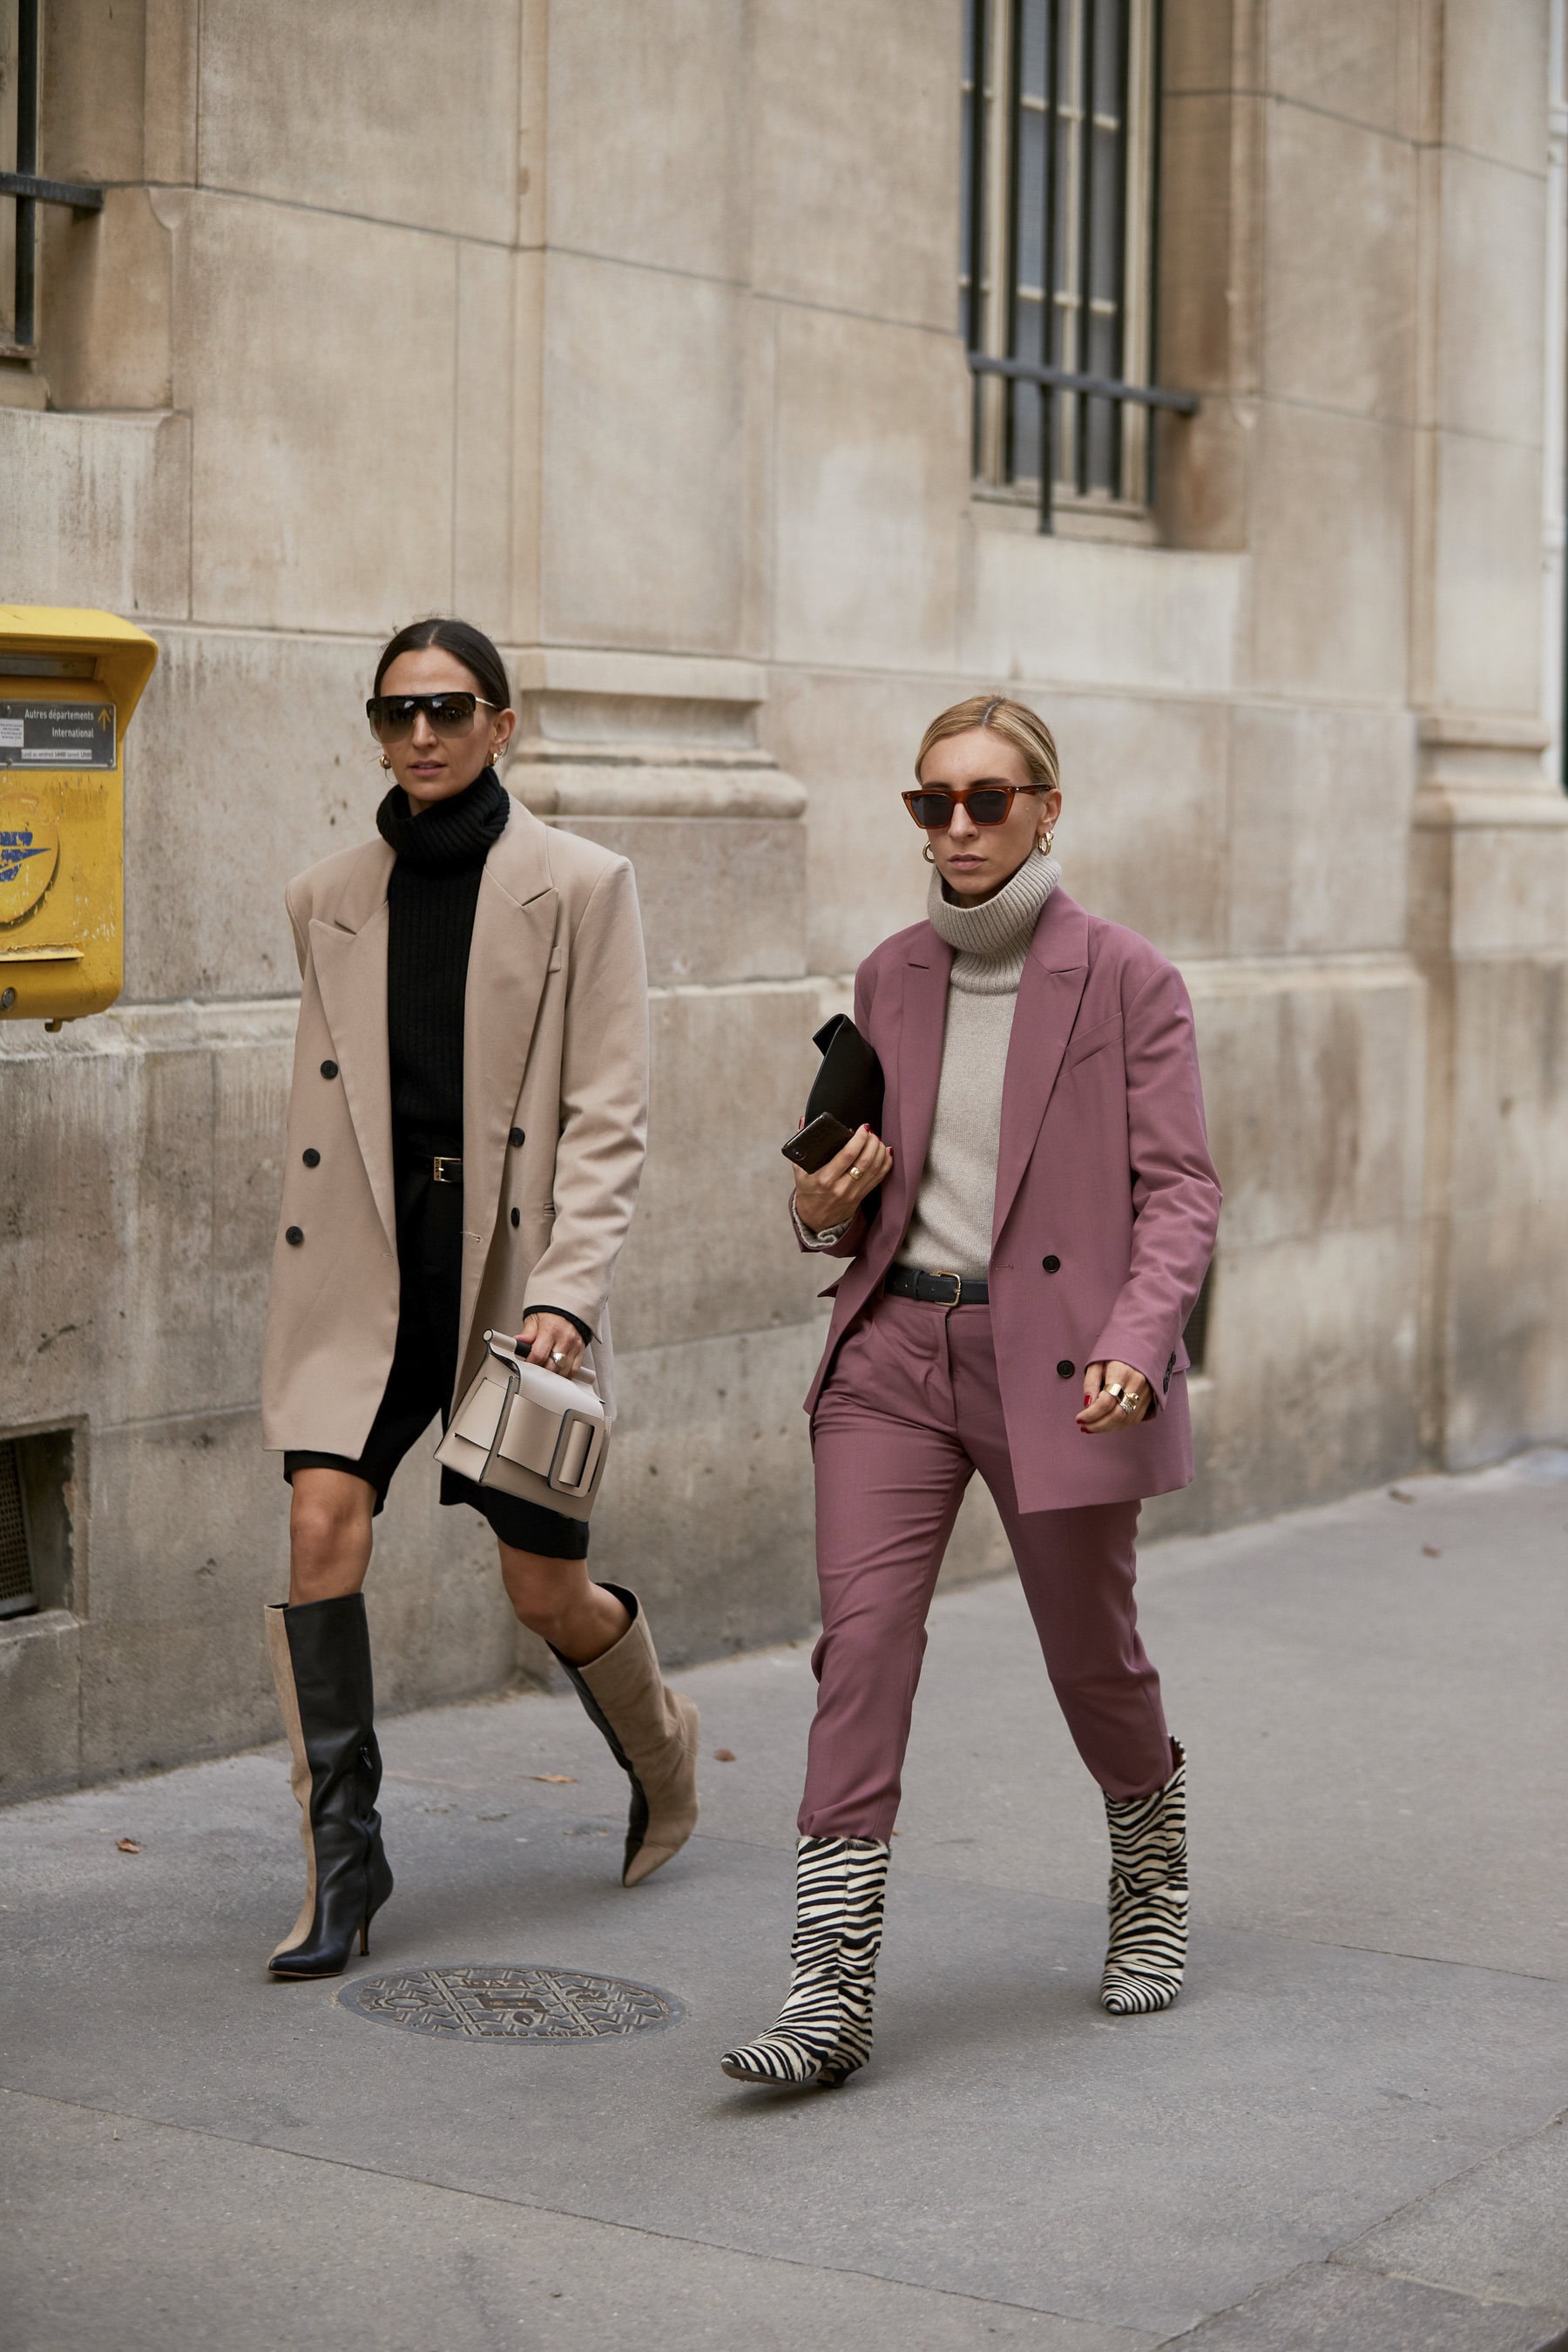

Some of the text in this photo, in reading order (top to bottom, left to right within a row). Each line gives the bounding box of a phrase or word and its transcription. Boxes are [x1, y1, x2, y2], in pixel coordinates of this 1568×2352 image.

[24, 708, 94, 721] Autres départements
[51, 727, 94, 739] International
[469, 1979, 524, 1988] GAZ
